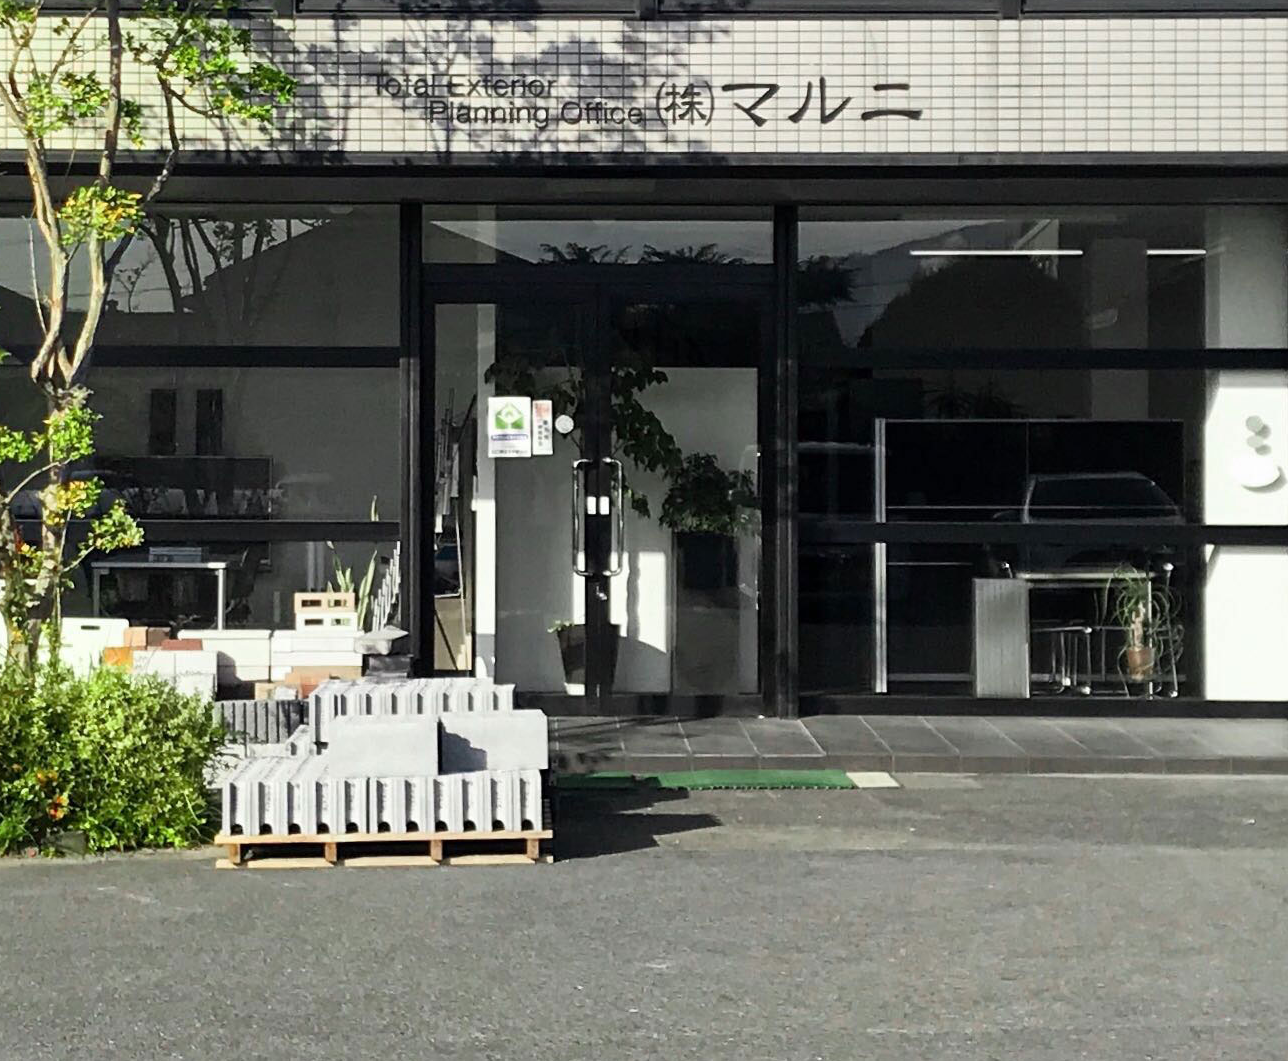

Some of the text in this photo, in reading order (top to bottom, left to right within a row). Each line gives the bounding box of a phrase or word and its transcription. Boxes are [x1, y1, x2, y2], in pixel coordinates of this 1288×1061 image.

[372, 74, 557, 97] Total Exterior
[429, 100, 643, 129] Planning Office
